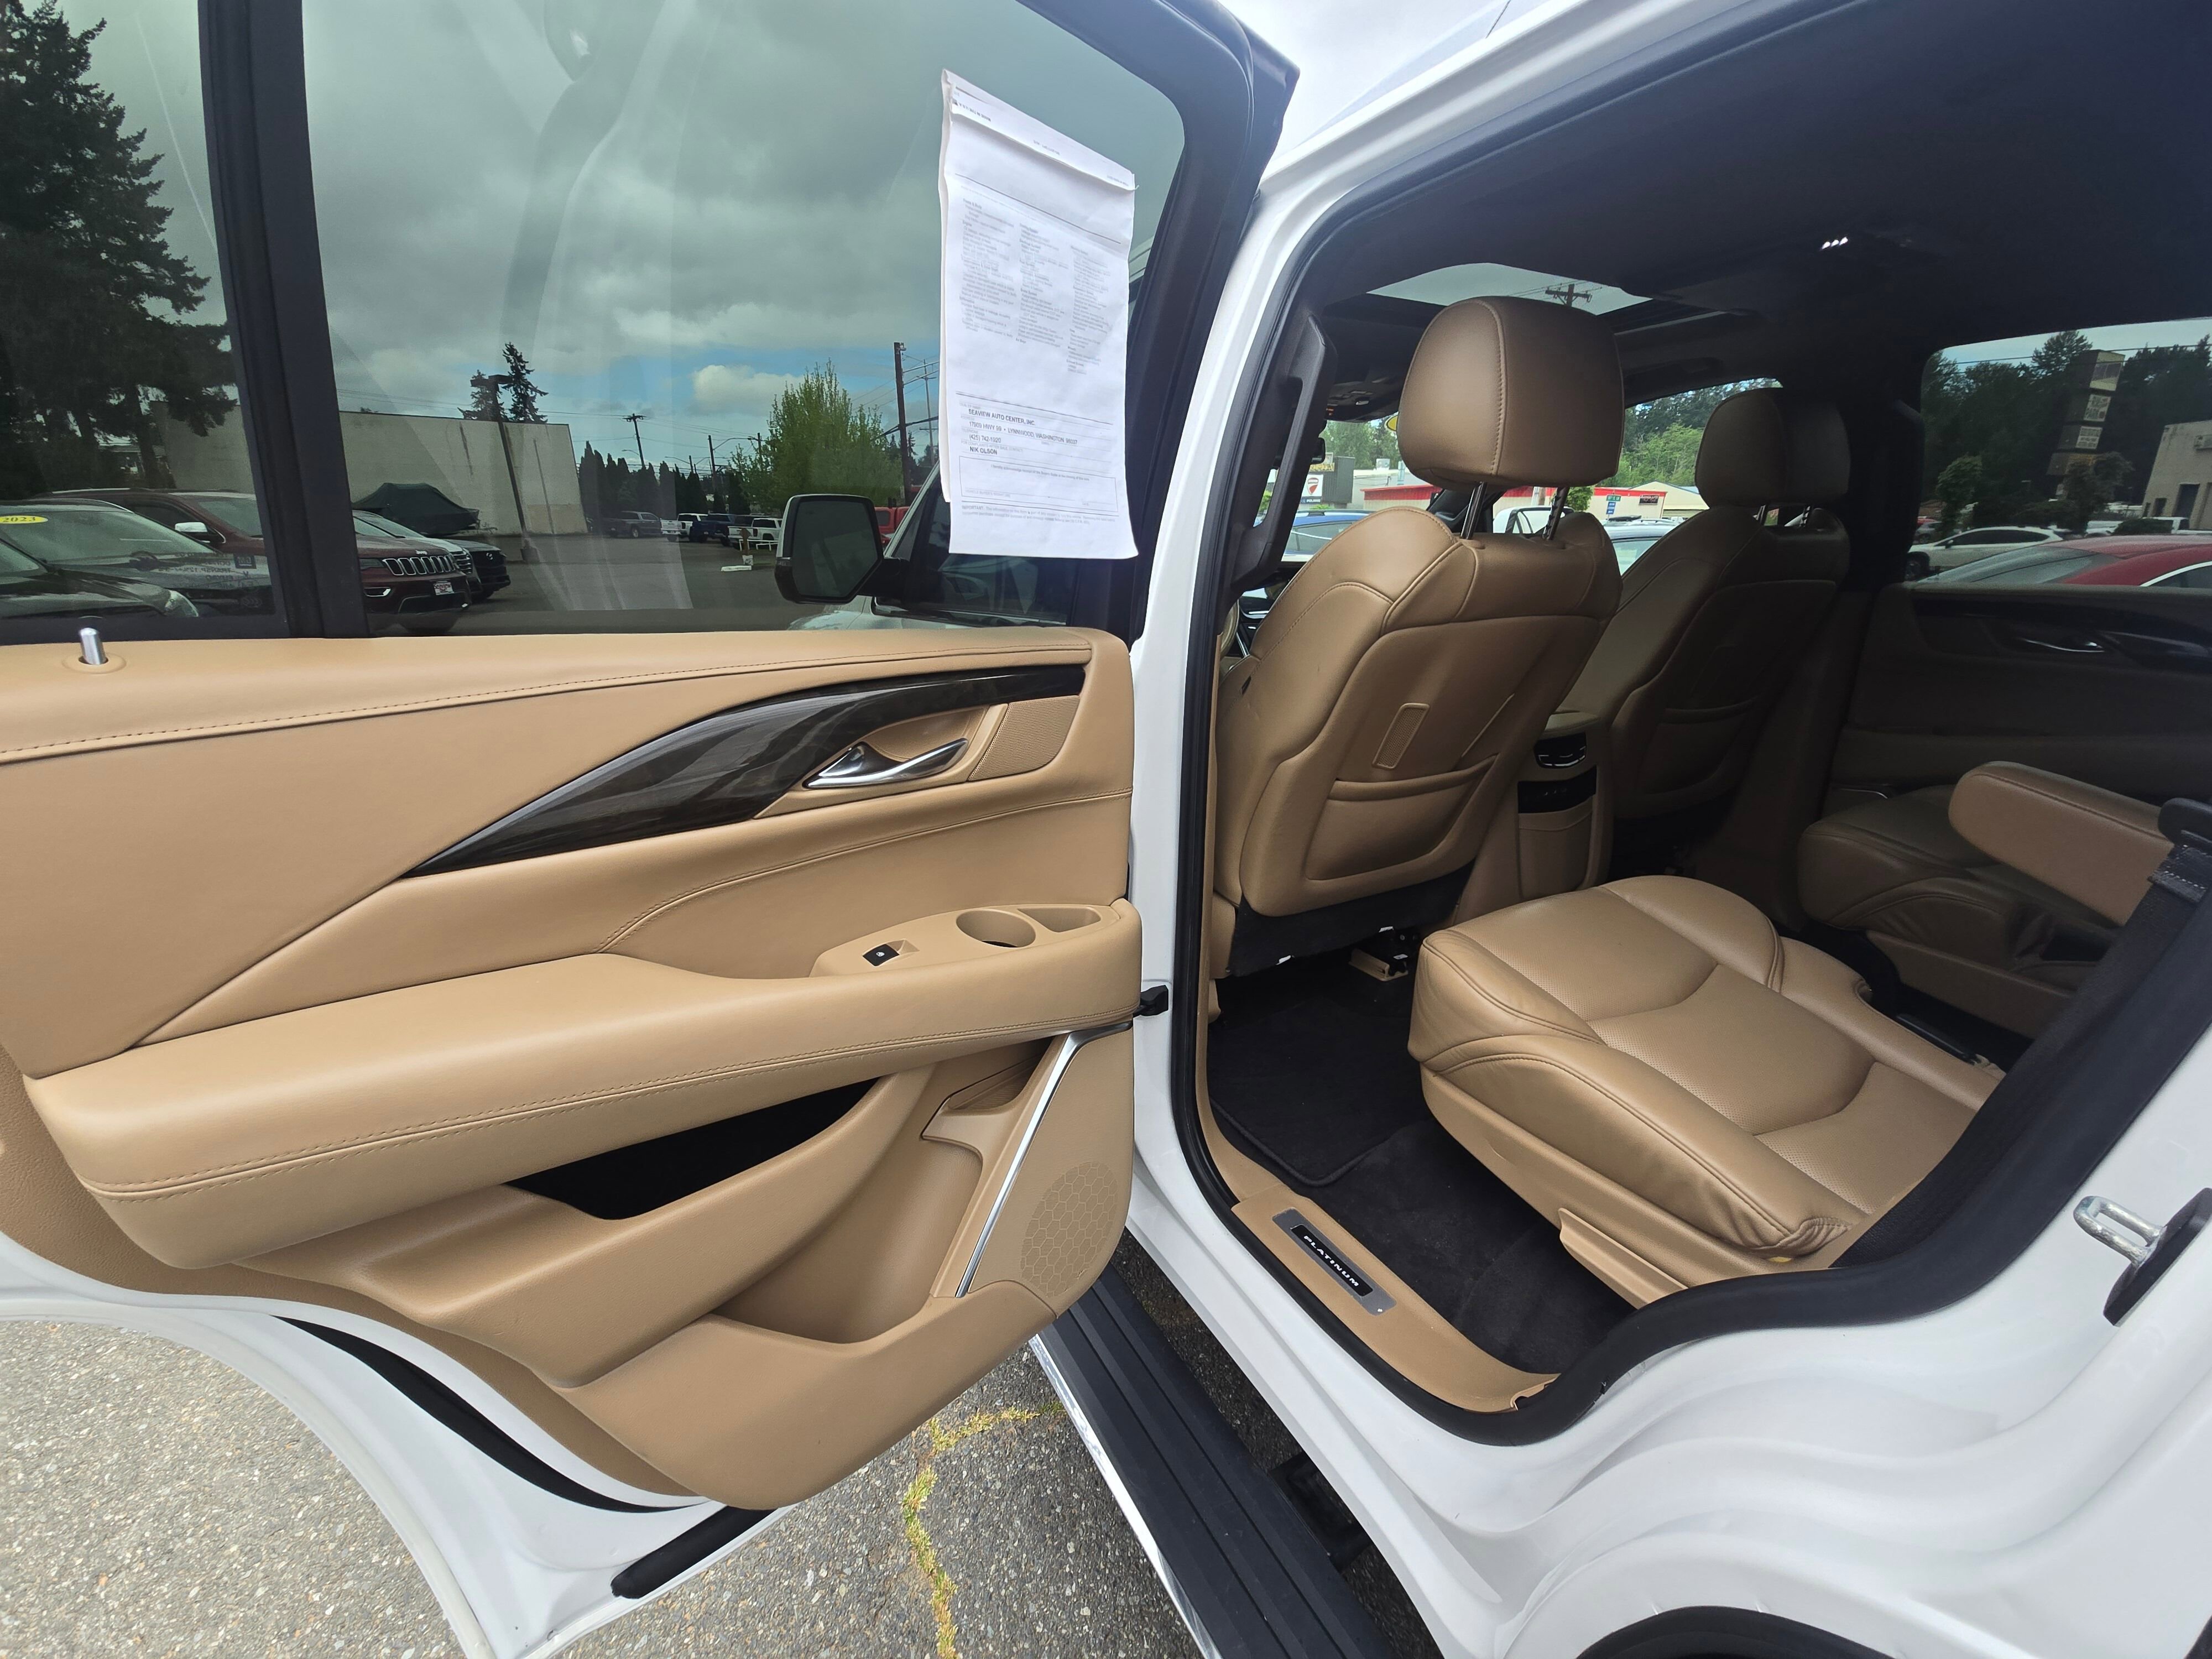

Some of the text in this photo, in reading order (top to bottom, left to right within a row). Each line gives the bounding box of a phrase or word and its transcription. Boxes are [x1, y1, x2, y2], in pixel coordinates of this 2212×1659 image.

[968, 409, 990, 418] SEAVIEW
[1005, 416, 1026, 425] CENTER,
[1036, 432, 1065, 443] WASHINGTON
[1303, 1235, 1359, 1286] PLATINUM
